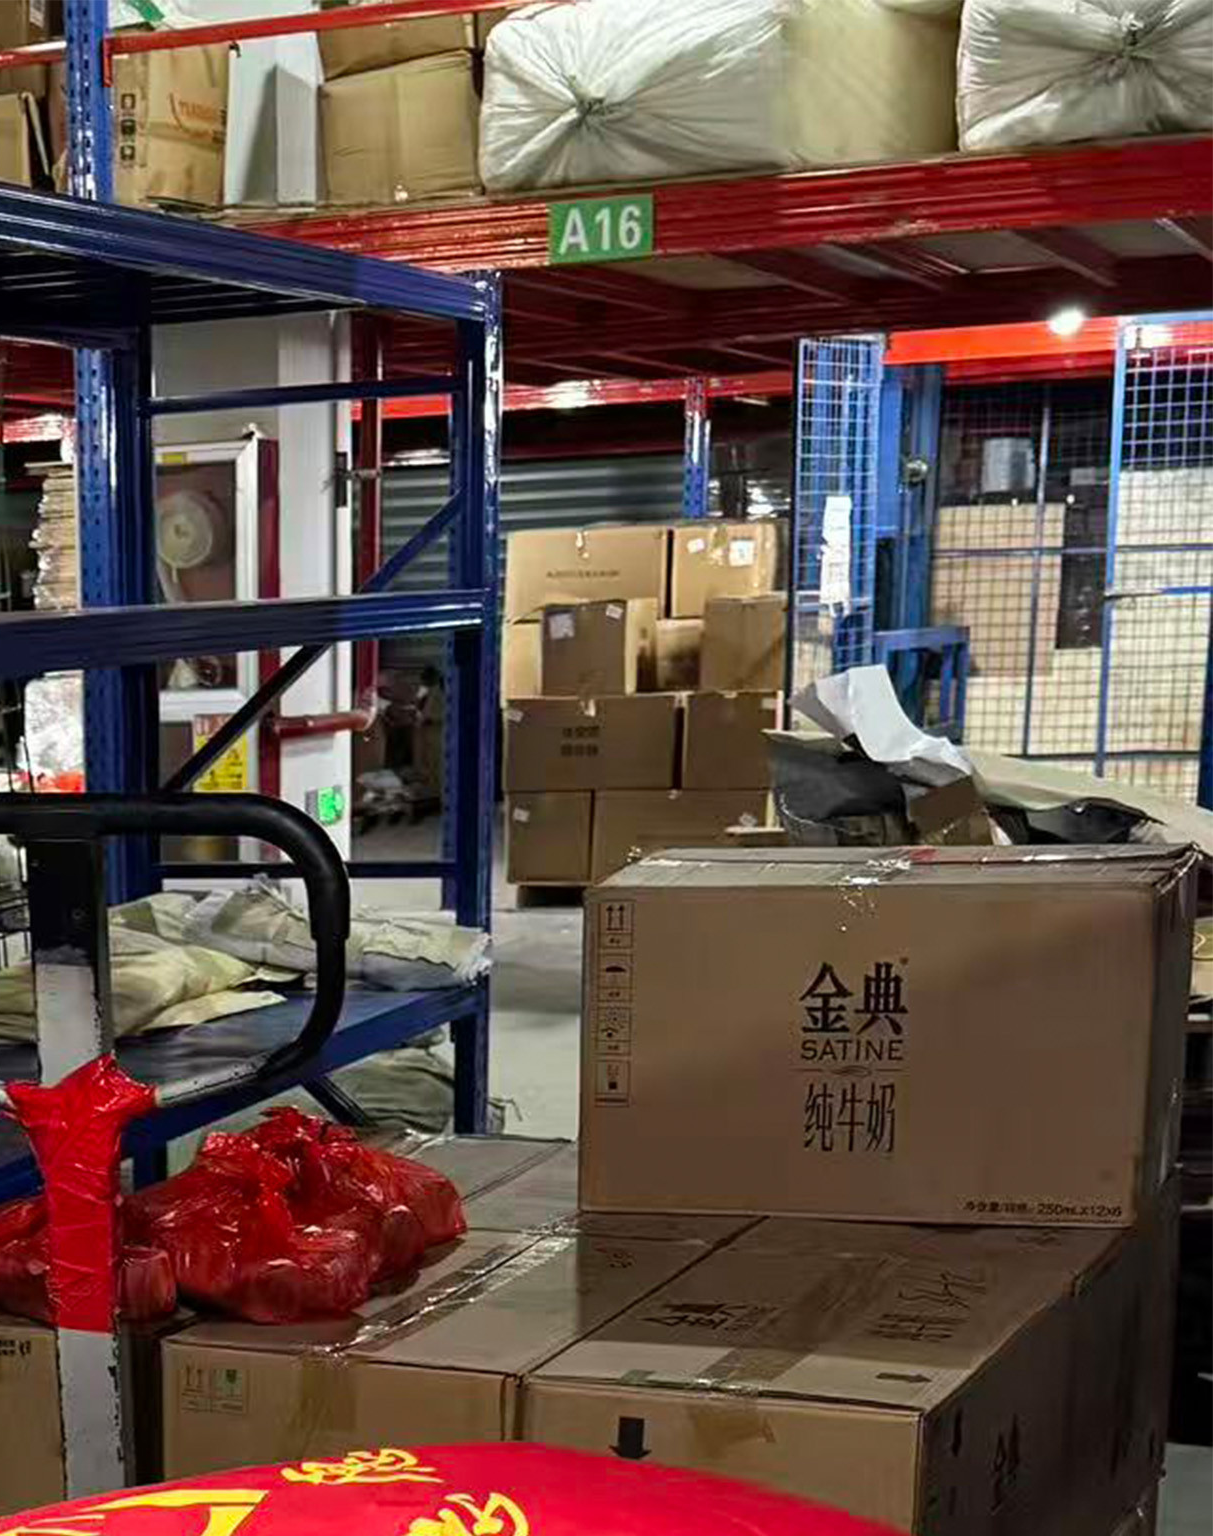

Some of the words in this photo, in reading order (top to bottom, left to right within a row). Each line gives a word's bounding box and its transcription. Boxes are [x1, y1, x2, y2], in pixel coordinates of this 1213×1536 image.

[559, 204, 642, 255] A16
[799, 961, 909, 1036] 金典
[800, 1038, 904, 1061] SATINE
[803, 1081, 896, 1153] 纯牛奶
